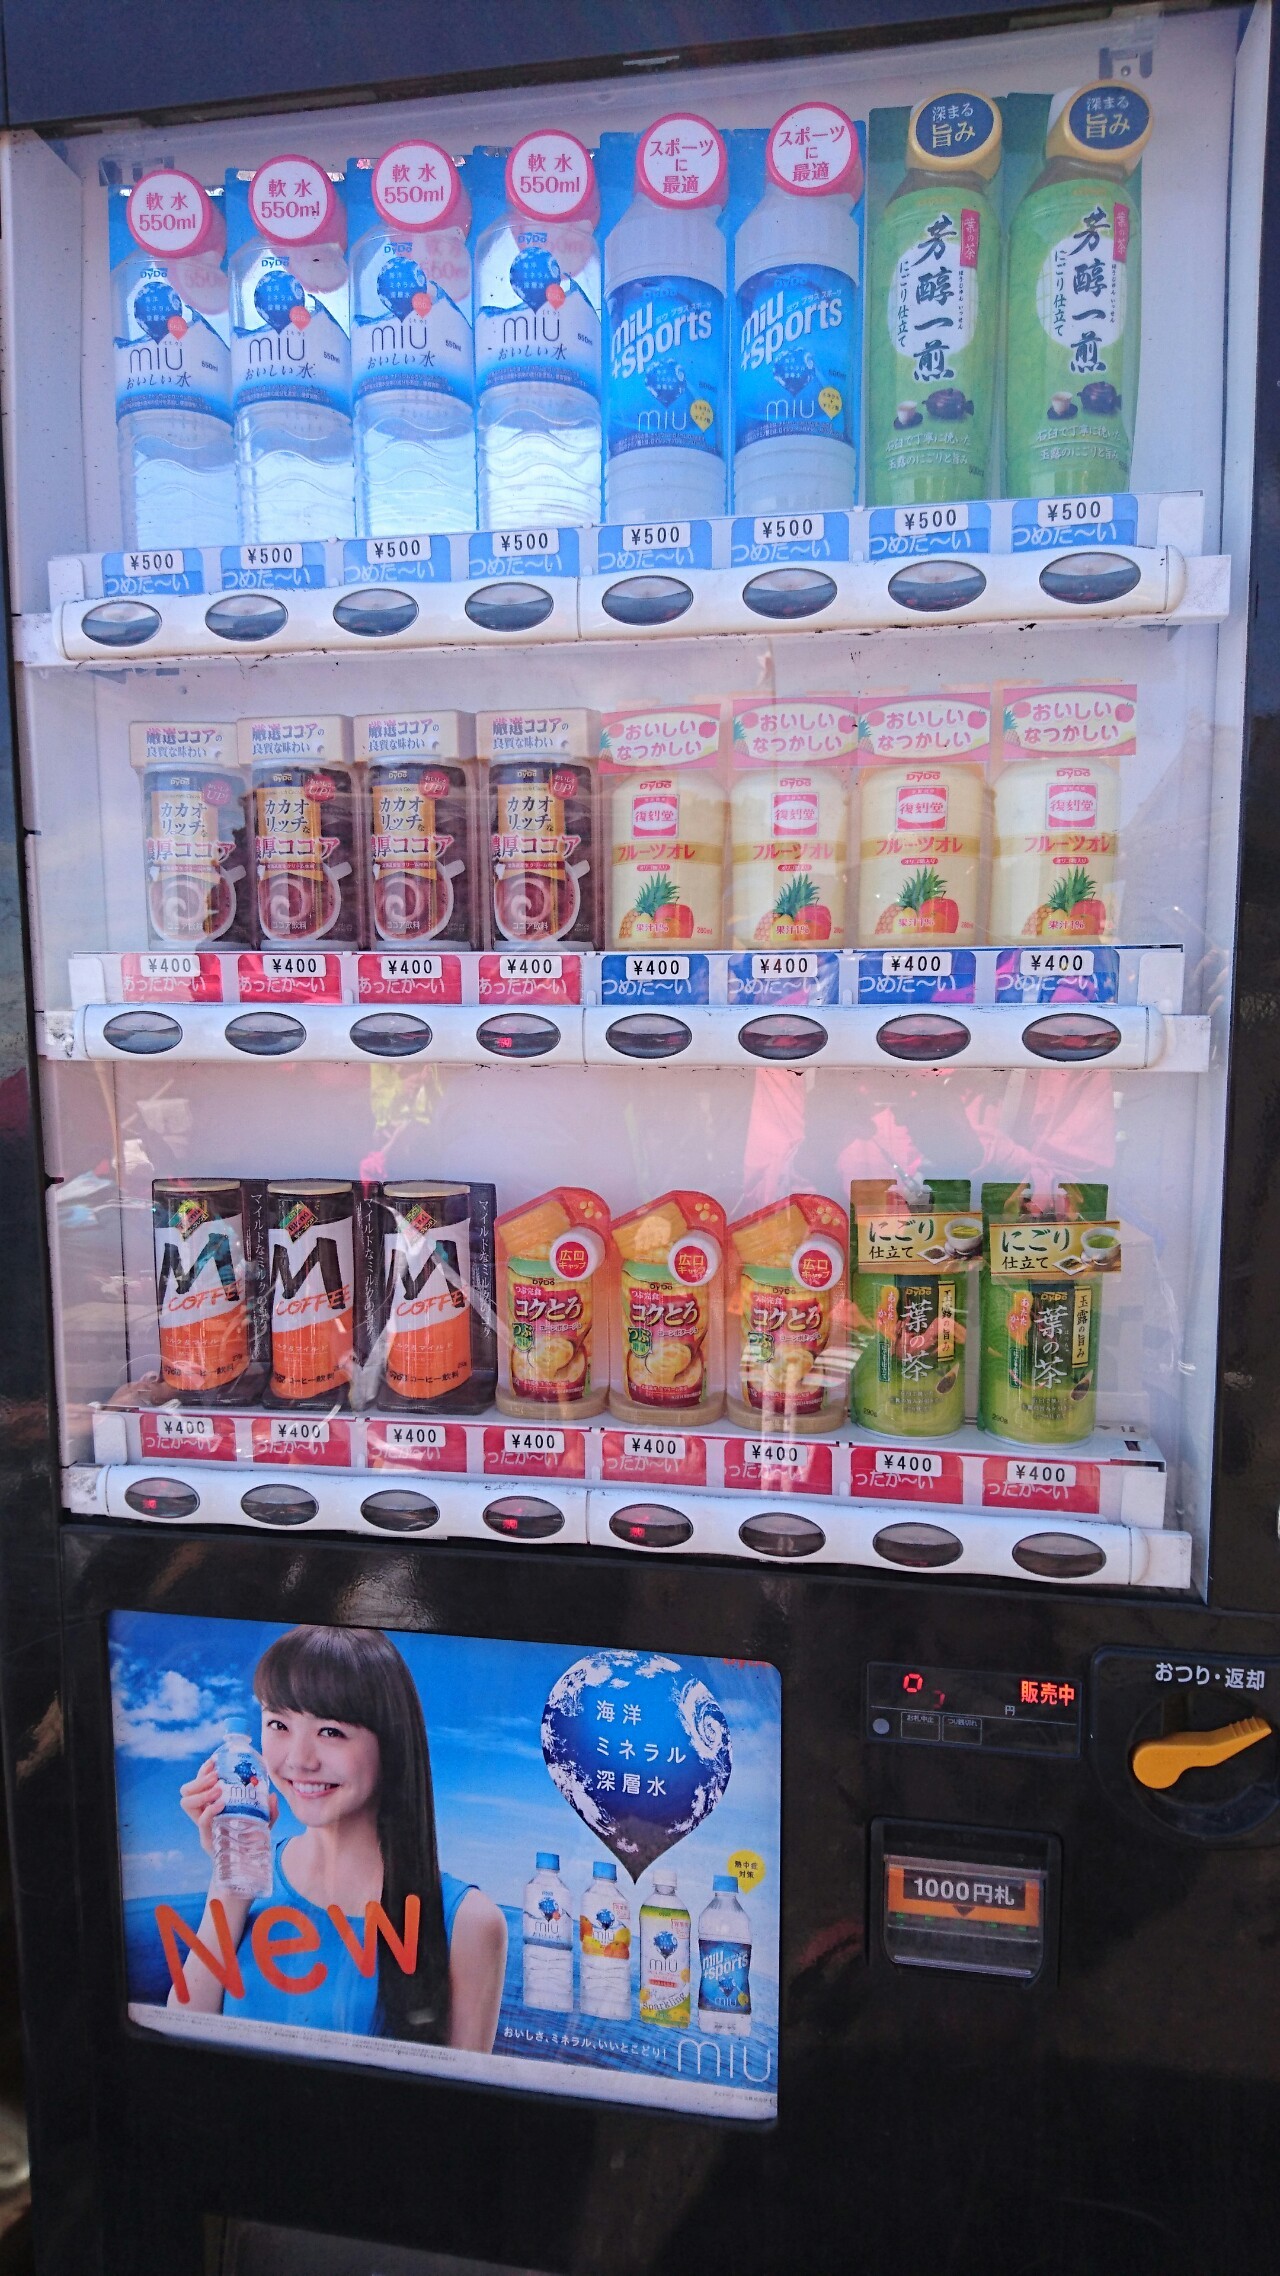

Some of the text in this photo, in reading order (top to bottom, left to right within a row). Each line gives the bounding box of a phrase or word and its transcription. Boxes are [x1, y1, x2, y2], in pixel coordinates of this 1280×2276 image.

[932, 103, 974, 121] 深まる
[1086, 97, 1129, 113] 深まる
[1086, 113, 1130, 139] 旨み
[779, 126, 846, 147] スポーツ
[932, 122, 976, 149] 旨み
[650, 138, 715, 157] スポーツ
[805, 147, 819, 160] に
[528, 153, 573, 173] 軟水
[675, 159, 688, 171] に
[792, 162, 830, 182] 最適
[392, 163, 437, 183] 軟水
[268, 178, 313, 198] 軟水
[520, 176, 580, 194] 550ml
[662, 175, 699, 194] 最適
[146, 192, 189, 211] 軟水
[384, 186, 444, 204] 550ml
[261, 201, 320, 219] 550ml
[139, 213, 196, 232] 550ml
[911, 214, 957, 382] 芳醇一煎
[1069, 206, 1111, 374] 芳醇一煎
[741, 290, 784, 354] miu
[611, 302, 653, 362] miu
[368, 351, 436, 370] おいしい水
[499, 343, 567, 361] おいしい水
[127, 372, 191, 389] おいしい水
[246, 363, 313, 381] おいしい水
[905, 510, 956, 530] ¥500
[1047, 501, 1101, 522] ¥500
[631, 527, 680, 545] ¥500
[762, 519, 813, 538] ¥500
[374, 540, 421, 558] ¥500
[500, 533, 548, 551] ¥500
[130, 553, 174, 571] ¥500
[248, 547, 292, 564] ¥500
[886, 709, 964, 730] おいしい
[1033, 702, 1111, 722] おいしい
[625, 720, 696, 741] おいしい
[760, 713, 835, 732] おいしい
[493, 736, 553, 750] 良質な味わい
[878, 731, 971, 750] なつかしい
[1024, 724, 1119, 744] なつかしい
[146, 746, 207, 759] 良質な味わい
[252, 741, 311, 755] 良質な味わい
[369, 738, 425, 752] 良質な味わい
[617, 740, 702, 761] なつかしい
[753, 735, 842, 754] なつかしい
[553, 782, 574, 794] UP!
[160, 802, 207, 819] カカオ
[265, 799, 309, 815] カカオ
[380, 796, 424, 812] カカオ
[508, 796, 554, 812] カカオ
[162, 819, 208, 838] リッチな
[266, 816, 311, 834] リッチな
[381, 814, 425, 832] リッチな
[508, 813, 554, 832] リッチな
[618, 844, 696, 861] フルーツオレ
[753, 844, 833, 860] フルーツオレ
[875, 836, 964, 855] フルーツオレ
[1024, 836, 1110, 854] フルーツオレ
[149, 958, 191, 973] ¥400
[272, 958, 317, 973] ¥400
[388, 959, 432, 975] ¥400
[507, 958, 553, 975] ¥400
[634, 960, 680, 975] ¥400
[760, 957, 808, 974] ¥400
[891, 955, 941, 972] ¥400
[1031, 954, 1083, 971] ¥400
[868, 1218, 935, 1243] にごり
[1002, 1228, 1070, 1252] にごり
[559, 1250, 584, 1262] 広口
[679, 1254, 705, 1266] 広口
[869, 1246, 914, 1260] 仕立て
[559, 1261, 586, 1271] キャップ
[803, 1258, 828, 1271] 広口
[1002, 1256, 1049, 1270] 仕立て
[515, 1296, 582, 1323] コクとろ
[632, 1301, 699, 1327] コクとろ
[754, 1305, 822, 1330] コクとろ
[1076, 1295, 1088, 1359] 玉露の旨み
[900, 1299, 934, 1383] 葉の茶
[1034, 1304, 1068, 1389] 葉の茶
[164, 1421, 205, 1435] ¥400
[278, 1424, 321, 1439] ¥400
[393, 1428, 437, 1444] ¥400
[511, 1434, 555, 1449] ¥400
[632, 1437, 676, 1455] ¥400
[751, 1444, 798, 1462] ¥400
[884, 1454, 932, 1472] ¥400
[1016, 1464, 1066, 1483] ¥400
[903, 1673, 923, 1693] 0
[1155, 1662, 1266, 1691] おつり・返却
[1020, 1680, 1075, 1707] 販売中
[597, 1700, 642, 1725] 海洋
[1004, 1705, 1016, 1717] 円
[596, 1736, 687, 1764] ミネラル
[596, 1769, 667, 1797] 深層水
[734, 1859, 759, 1870] 熱中症
[739, 1869, 755, 1879] 対策
[913, 1877, 1015, 1906] 1000円札
[154, 1894, 421, 2005] New
[642, 1992, 688, 2013] Sparkling
